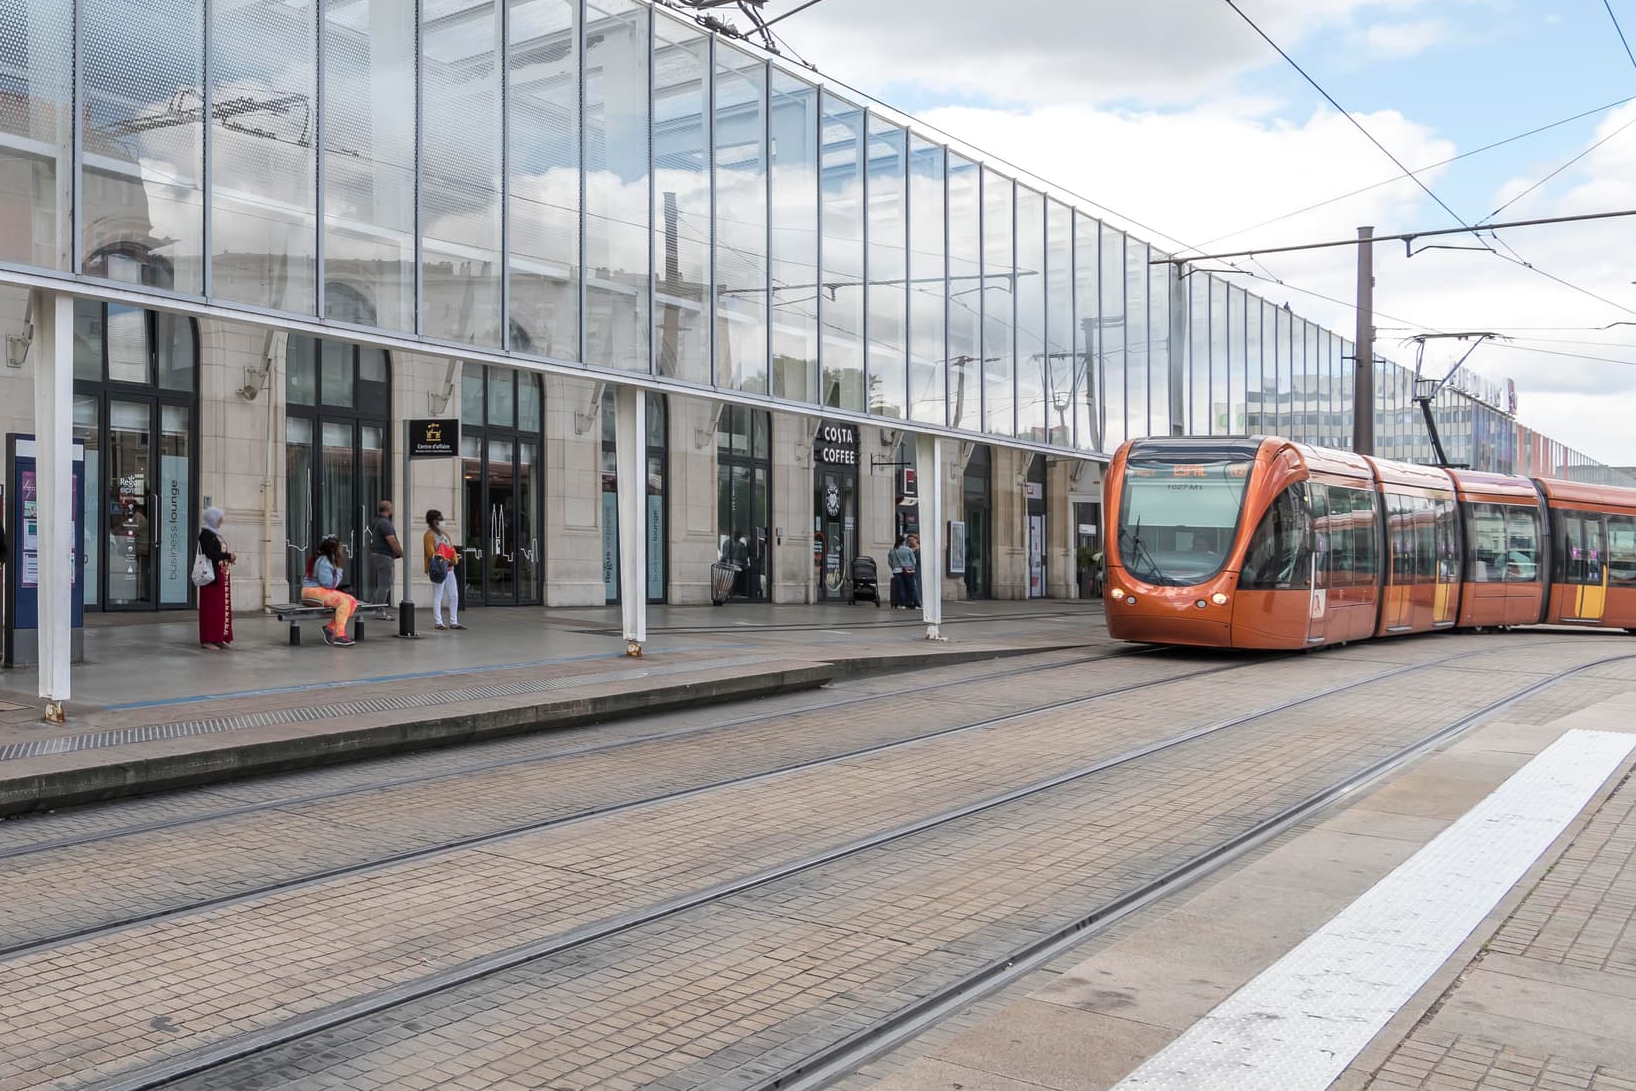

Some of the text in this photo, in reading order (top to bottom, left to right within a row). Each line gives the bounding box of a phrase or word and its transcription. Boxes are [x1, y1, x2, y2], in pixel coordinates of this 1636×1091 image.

[825, 427, 853, 443] COSTA
[823, 447, 855, 464] COFFEE
[169, 479, 180, 581] business lounge
